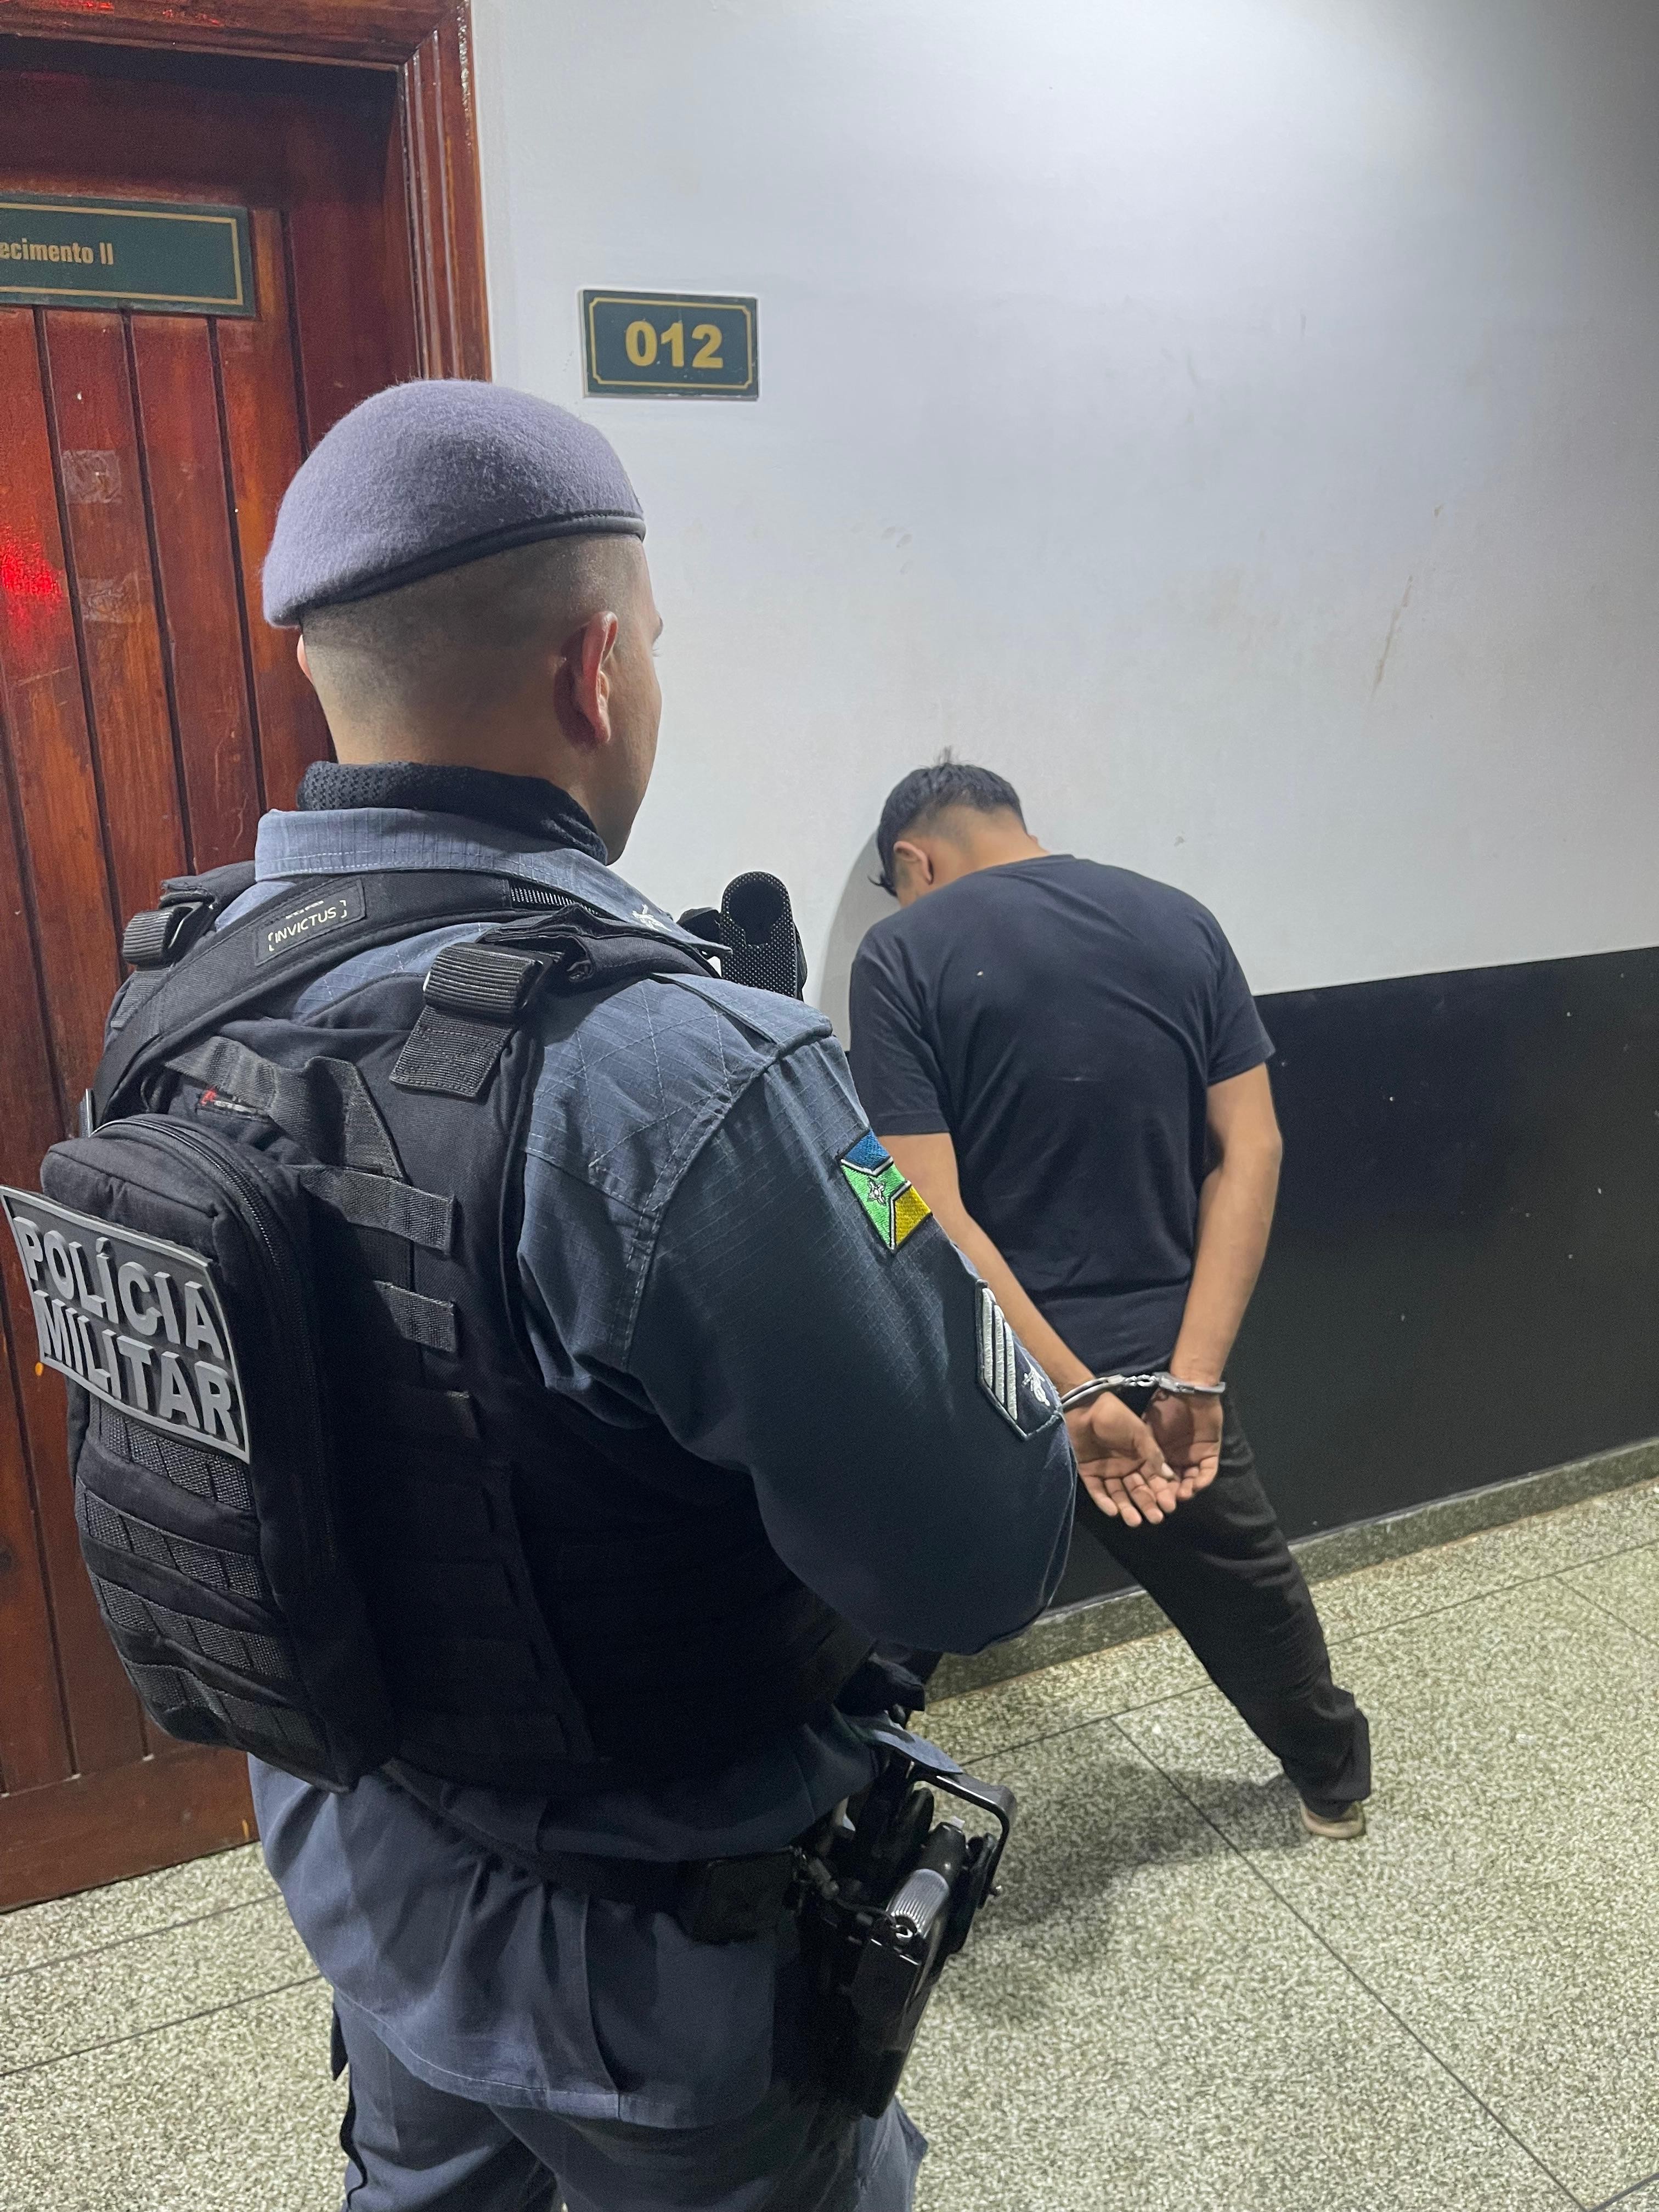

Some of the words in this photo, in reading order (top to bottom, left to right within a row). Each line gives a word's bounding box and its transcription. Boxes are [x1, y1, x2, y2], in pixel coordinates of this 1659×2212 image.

[0, 238, 94, 263] ecimento
[625, 320, 724, 368] 012
[274, 906, 336, 943] INVICTUS
[14, 1216, 224, 1361] POLÍCIA
[33, 1289, 239, 1445] MILITAR
